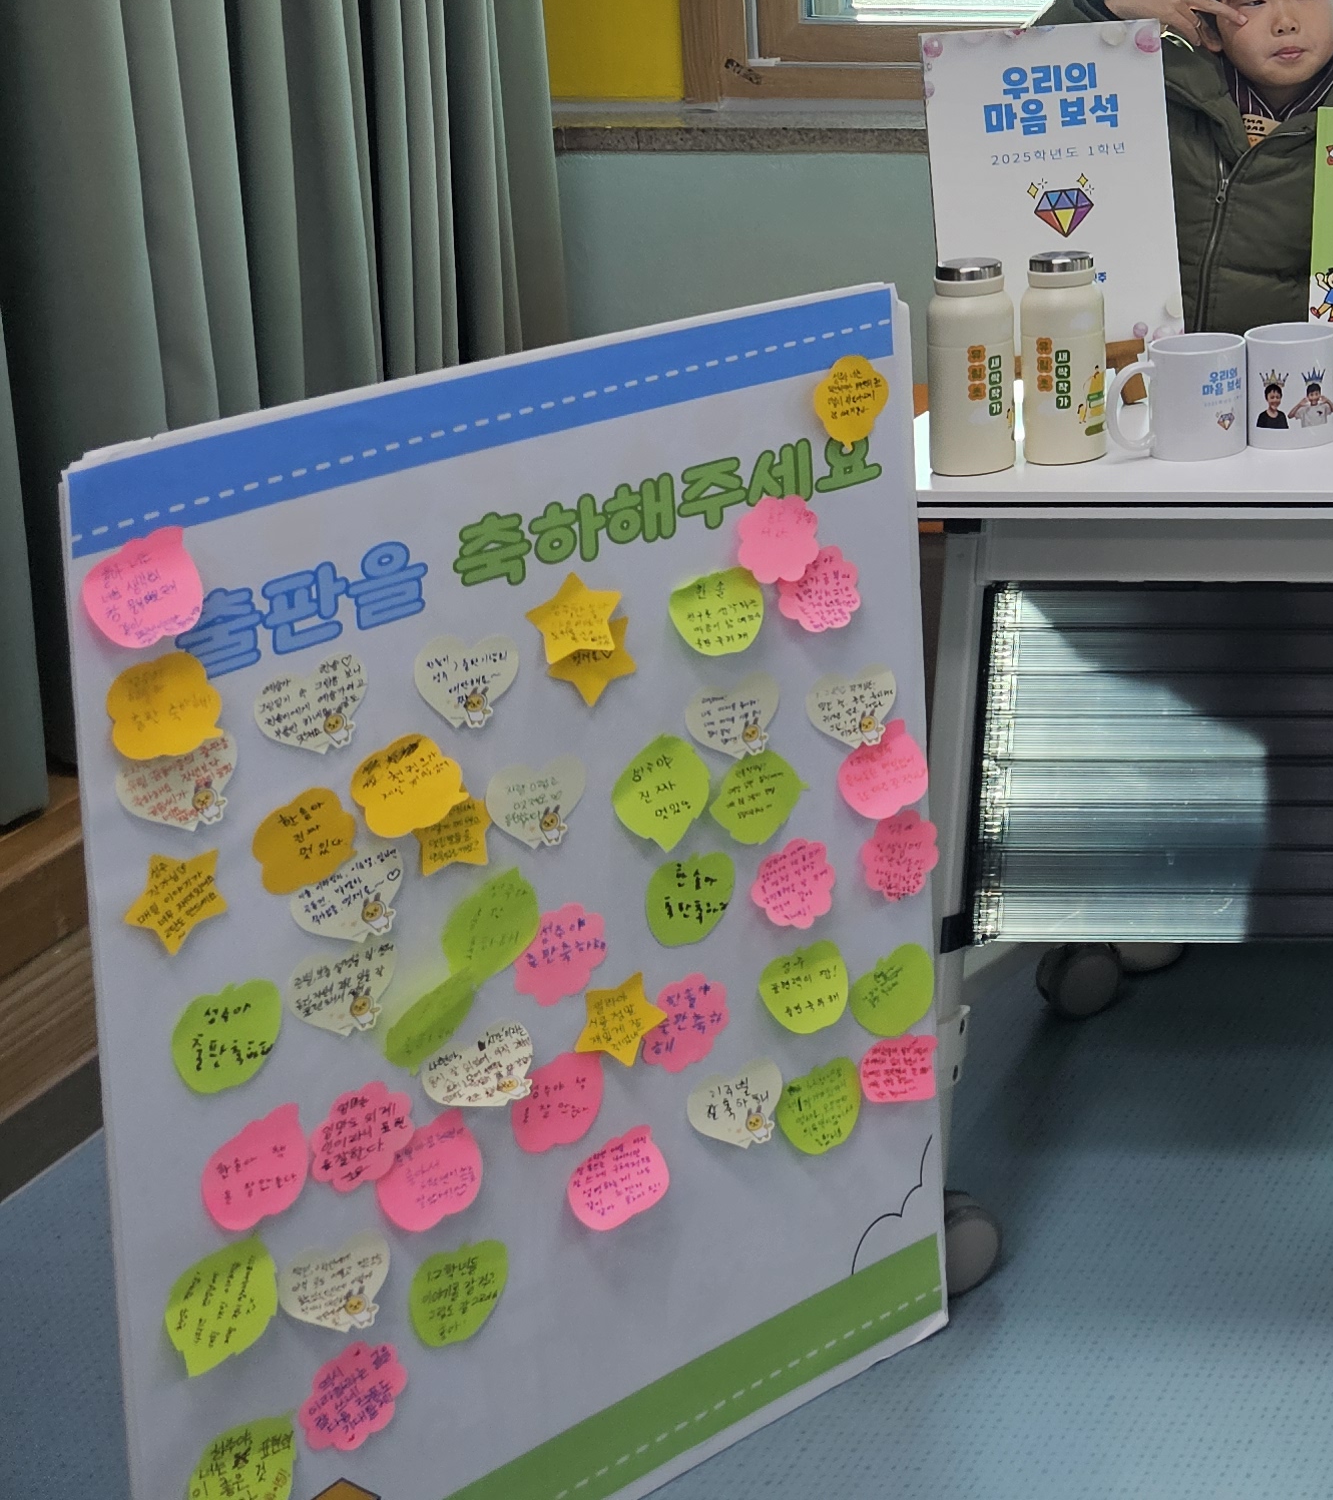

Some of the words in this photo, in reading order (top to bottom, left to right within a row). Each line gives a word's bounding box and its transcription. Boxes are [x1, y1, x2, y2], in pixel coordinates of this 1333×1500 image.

[1002, 62, 1098, 99] 우리의
[984, 97, 1047, 136] 마음
[1060, 94, 1119, 128] 보석
[991, 146, 1080, 166] 2025학년도
[1088, 141, 1126, 157] 1학년
[1057, 351, 1069, 407] 새싹작가
[1202, 382, 1223, 396] 마음
[1209, 367, 1238, 383] 우리의
[175, 540, 428, 678] 출판을
[453, 435, 883, 587] 축하해주세요
